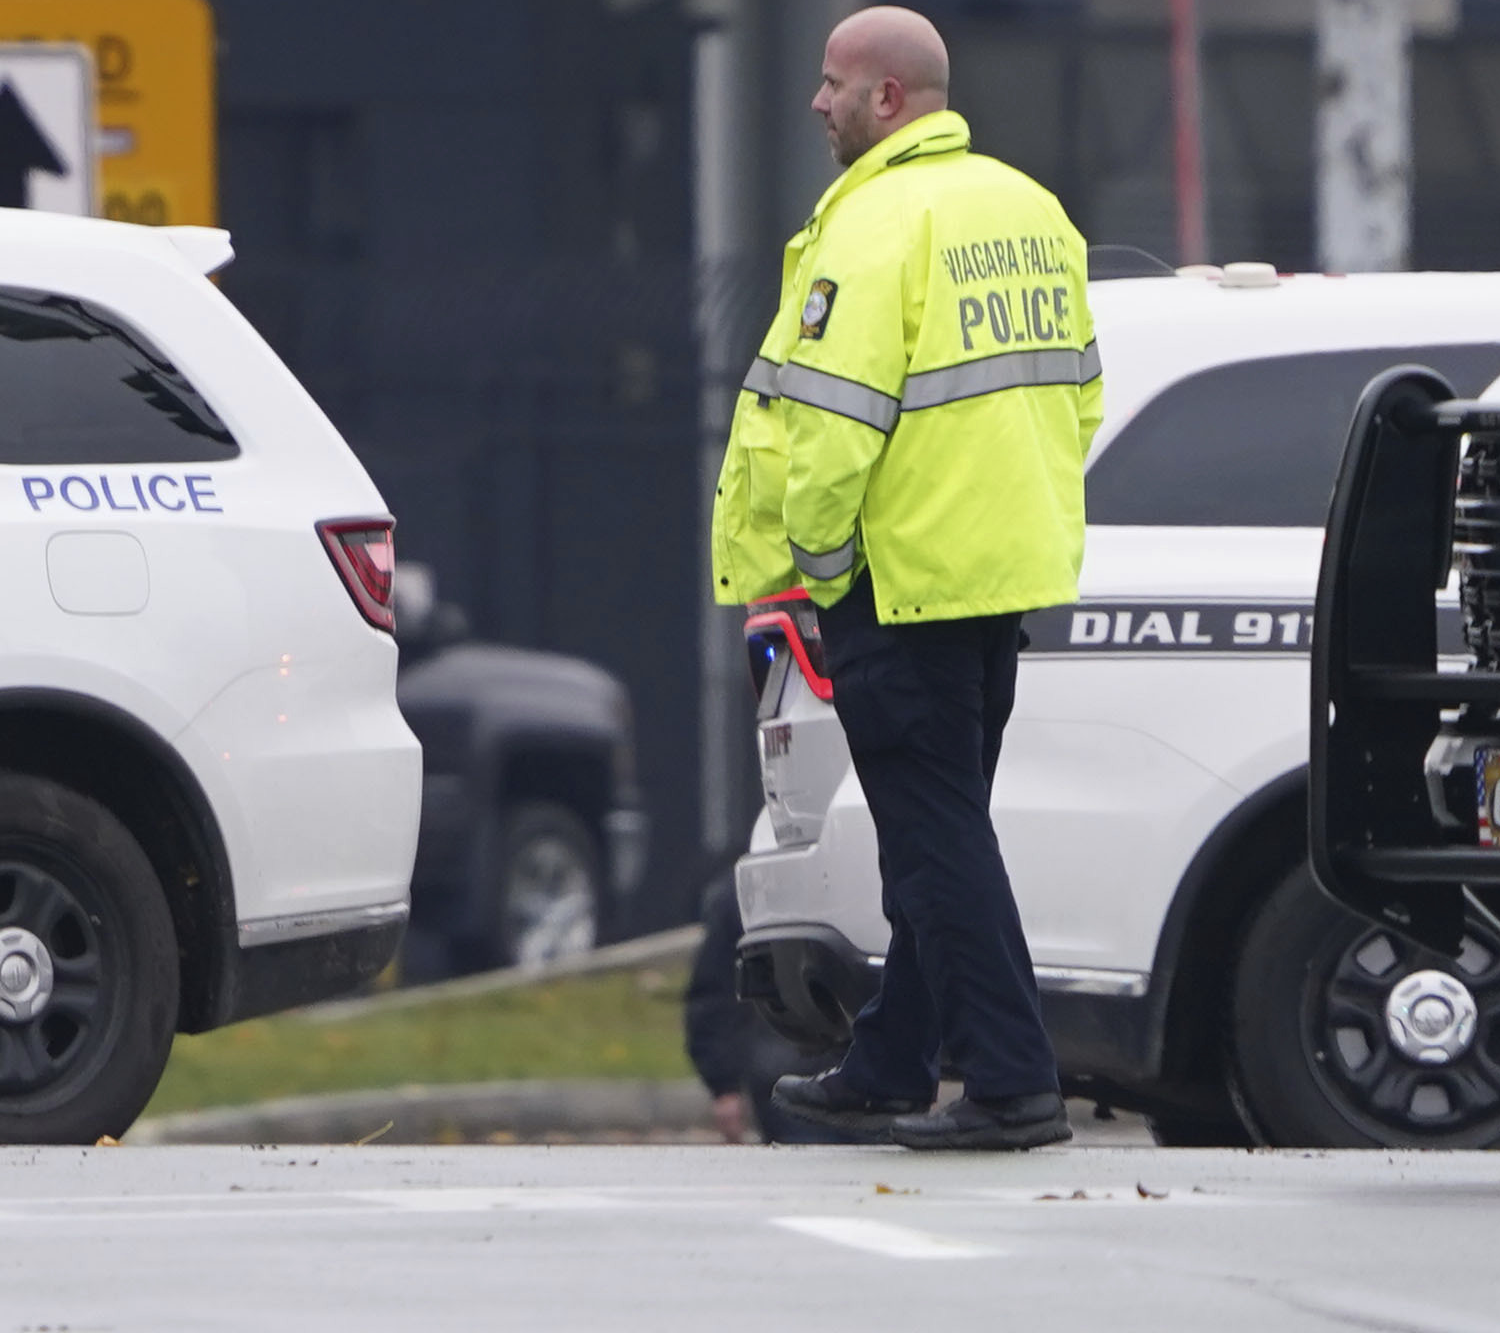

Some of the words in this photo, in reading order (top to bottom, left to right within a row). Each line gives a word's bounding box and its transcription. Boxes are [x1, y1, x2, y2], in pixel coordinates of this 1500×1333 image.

[958, 286, 1071, 351] POLICE
[21, 474, 224, 513] POLICE
[1069, 611, 1213, 645] DIAL
